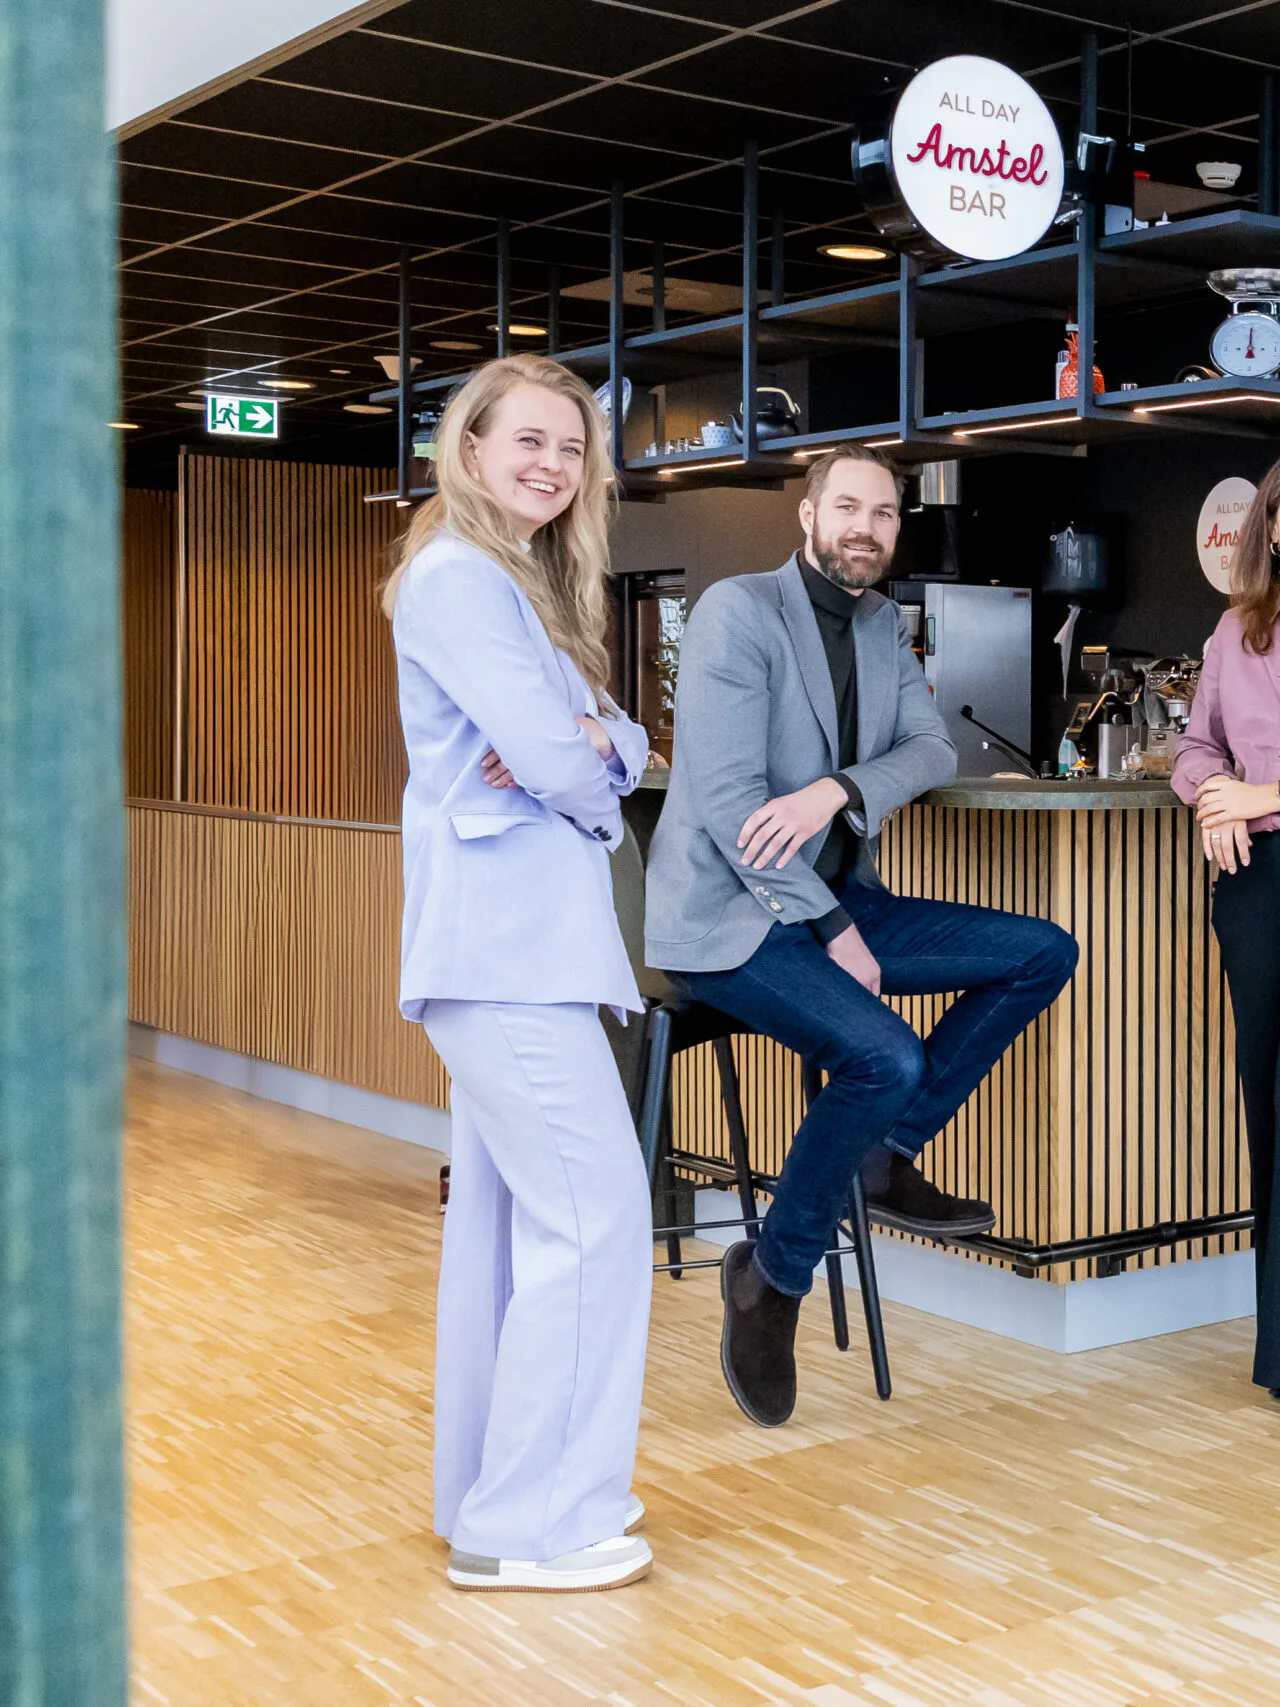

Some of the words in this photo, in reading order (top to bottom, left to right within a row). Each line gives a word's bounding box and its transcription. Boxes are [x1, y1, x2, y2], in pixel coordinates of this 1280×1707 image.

[939, 91, 976, 115] ALL
[982, 99, 1020, 123] DAY
[907, 123, 1048, 186] Amstel
[950, 185, 1006, 219] BAR
[1216, 504, 1231, 514] ALL
[1233, 502, 1251, 513] DAY
[1204, 522, 1239, 548] Ams
